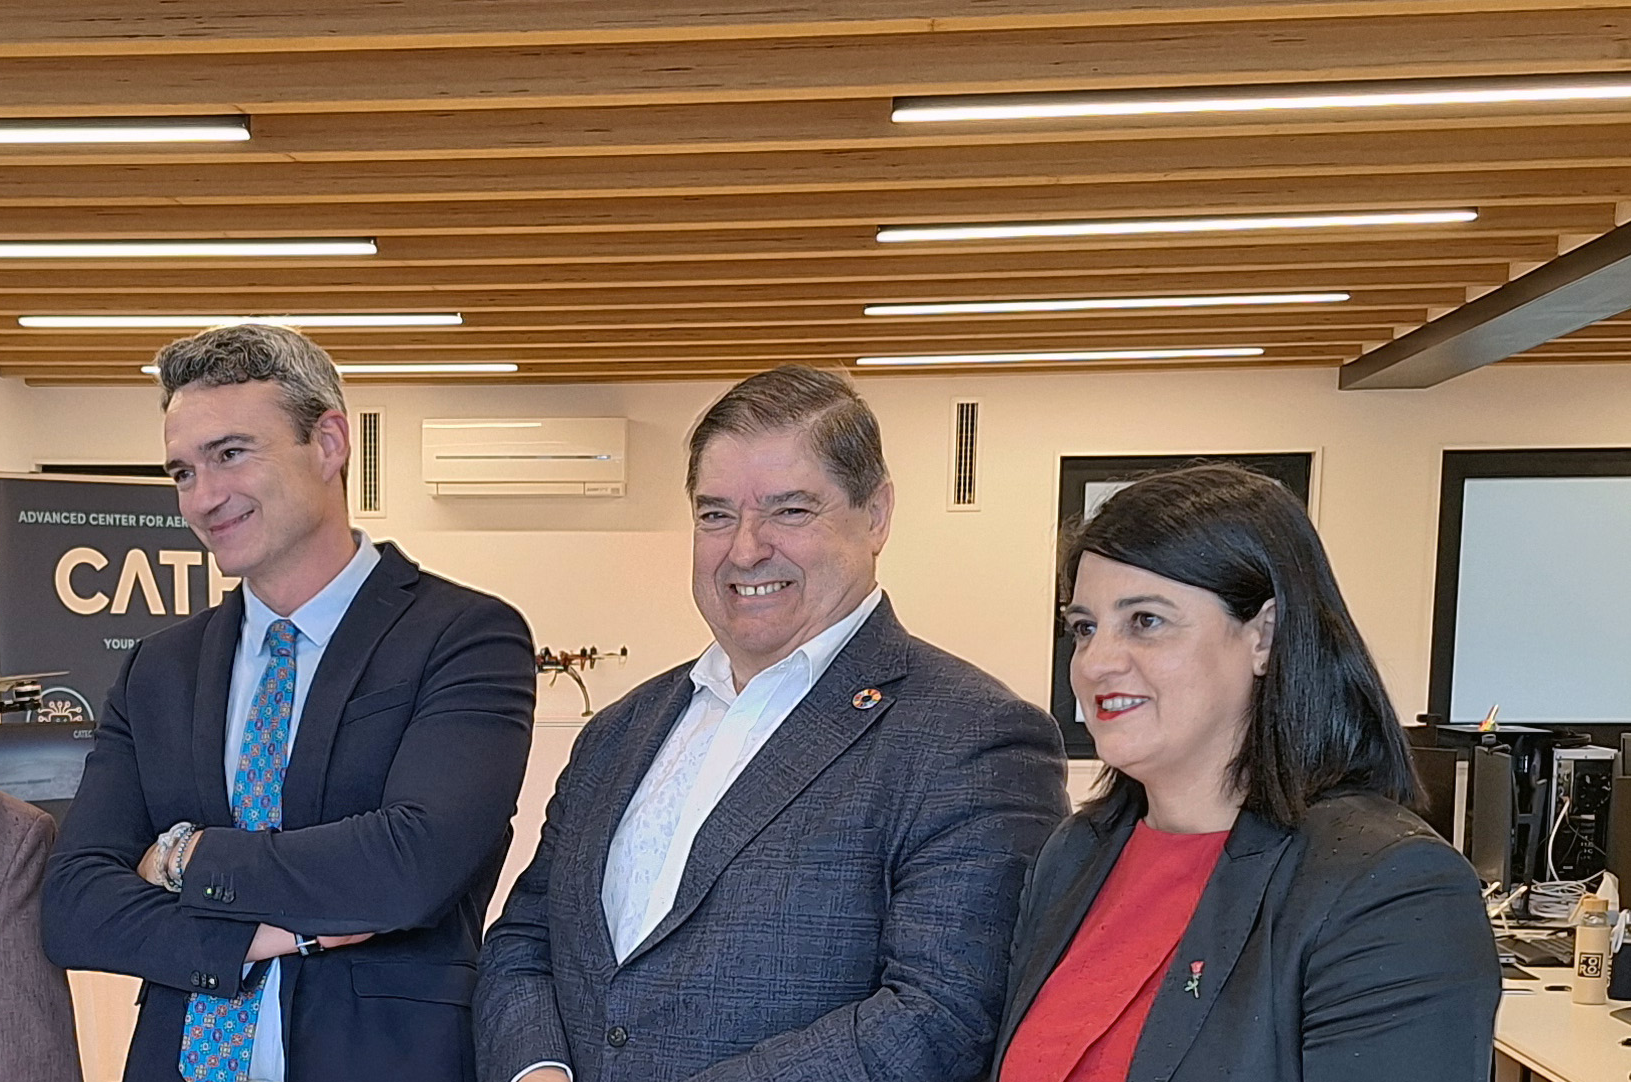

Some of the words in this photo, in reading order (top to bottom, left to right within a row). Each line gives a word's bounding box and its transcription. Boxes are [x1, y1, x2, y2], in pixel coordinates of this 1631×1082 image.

[18, 510, 86, 525] ADVANCED
[89, 513, 136, 527] CENTER
[139, 515, 163, 527] FOR
[166, 515, 189, 528] AER
